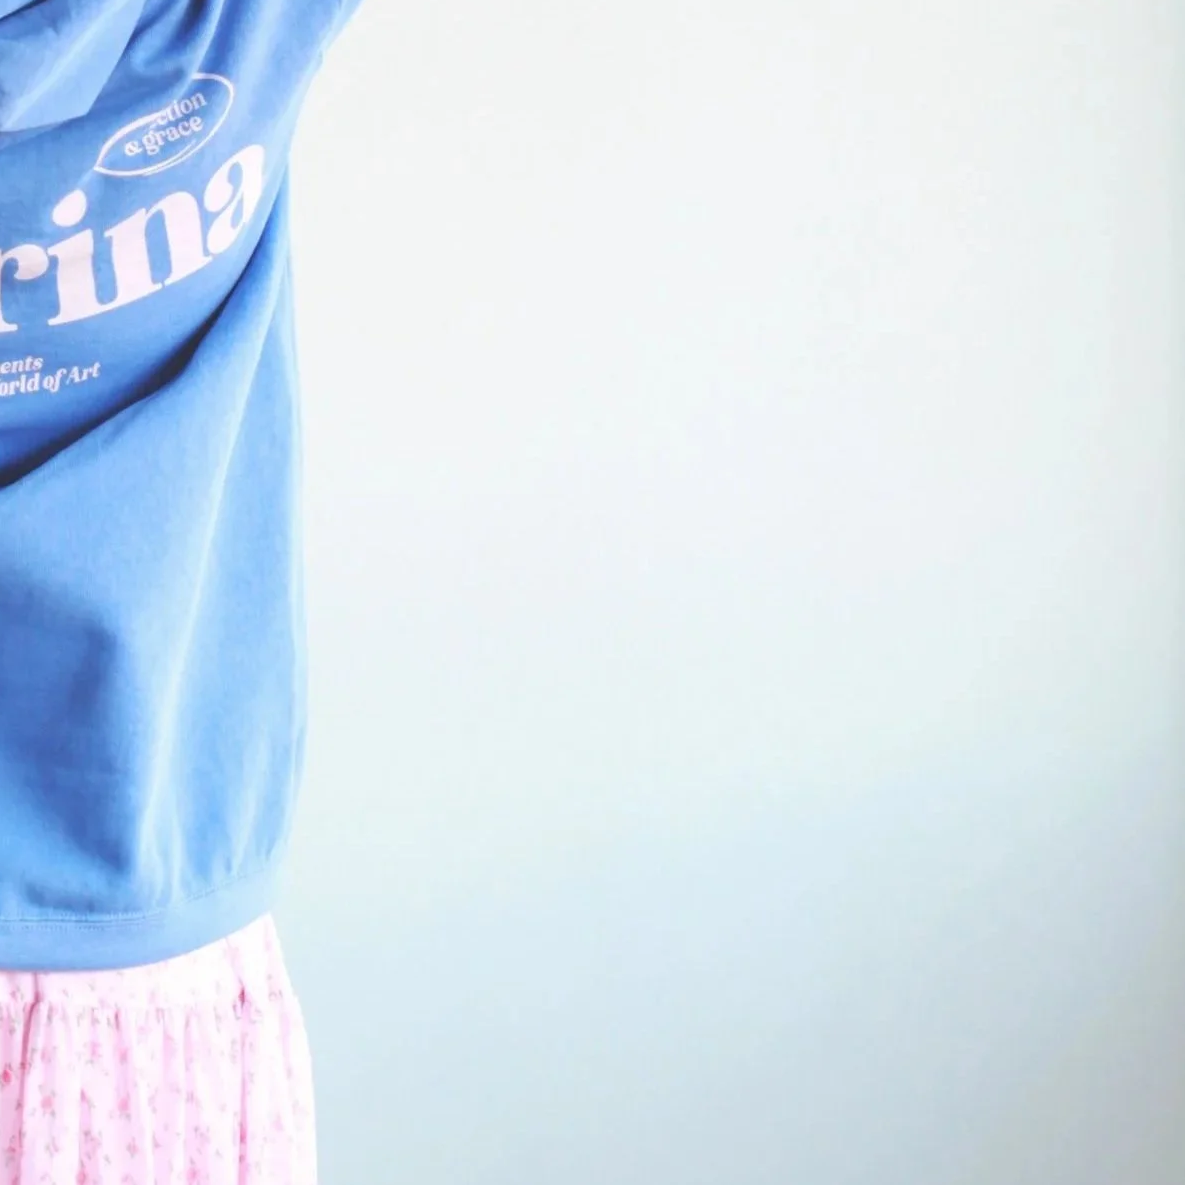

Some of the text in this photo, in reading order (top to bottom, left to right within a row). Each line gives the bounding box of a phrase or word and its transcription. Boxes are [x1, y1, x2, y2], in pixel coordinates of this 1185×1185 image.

[124, 115, 203, 156] & grace
[42, 367, 67, 394] of
[65, 361, 101, 385] Art
